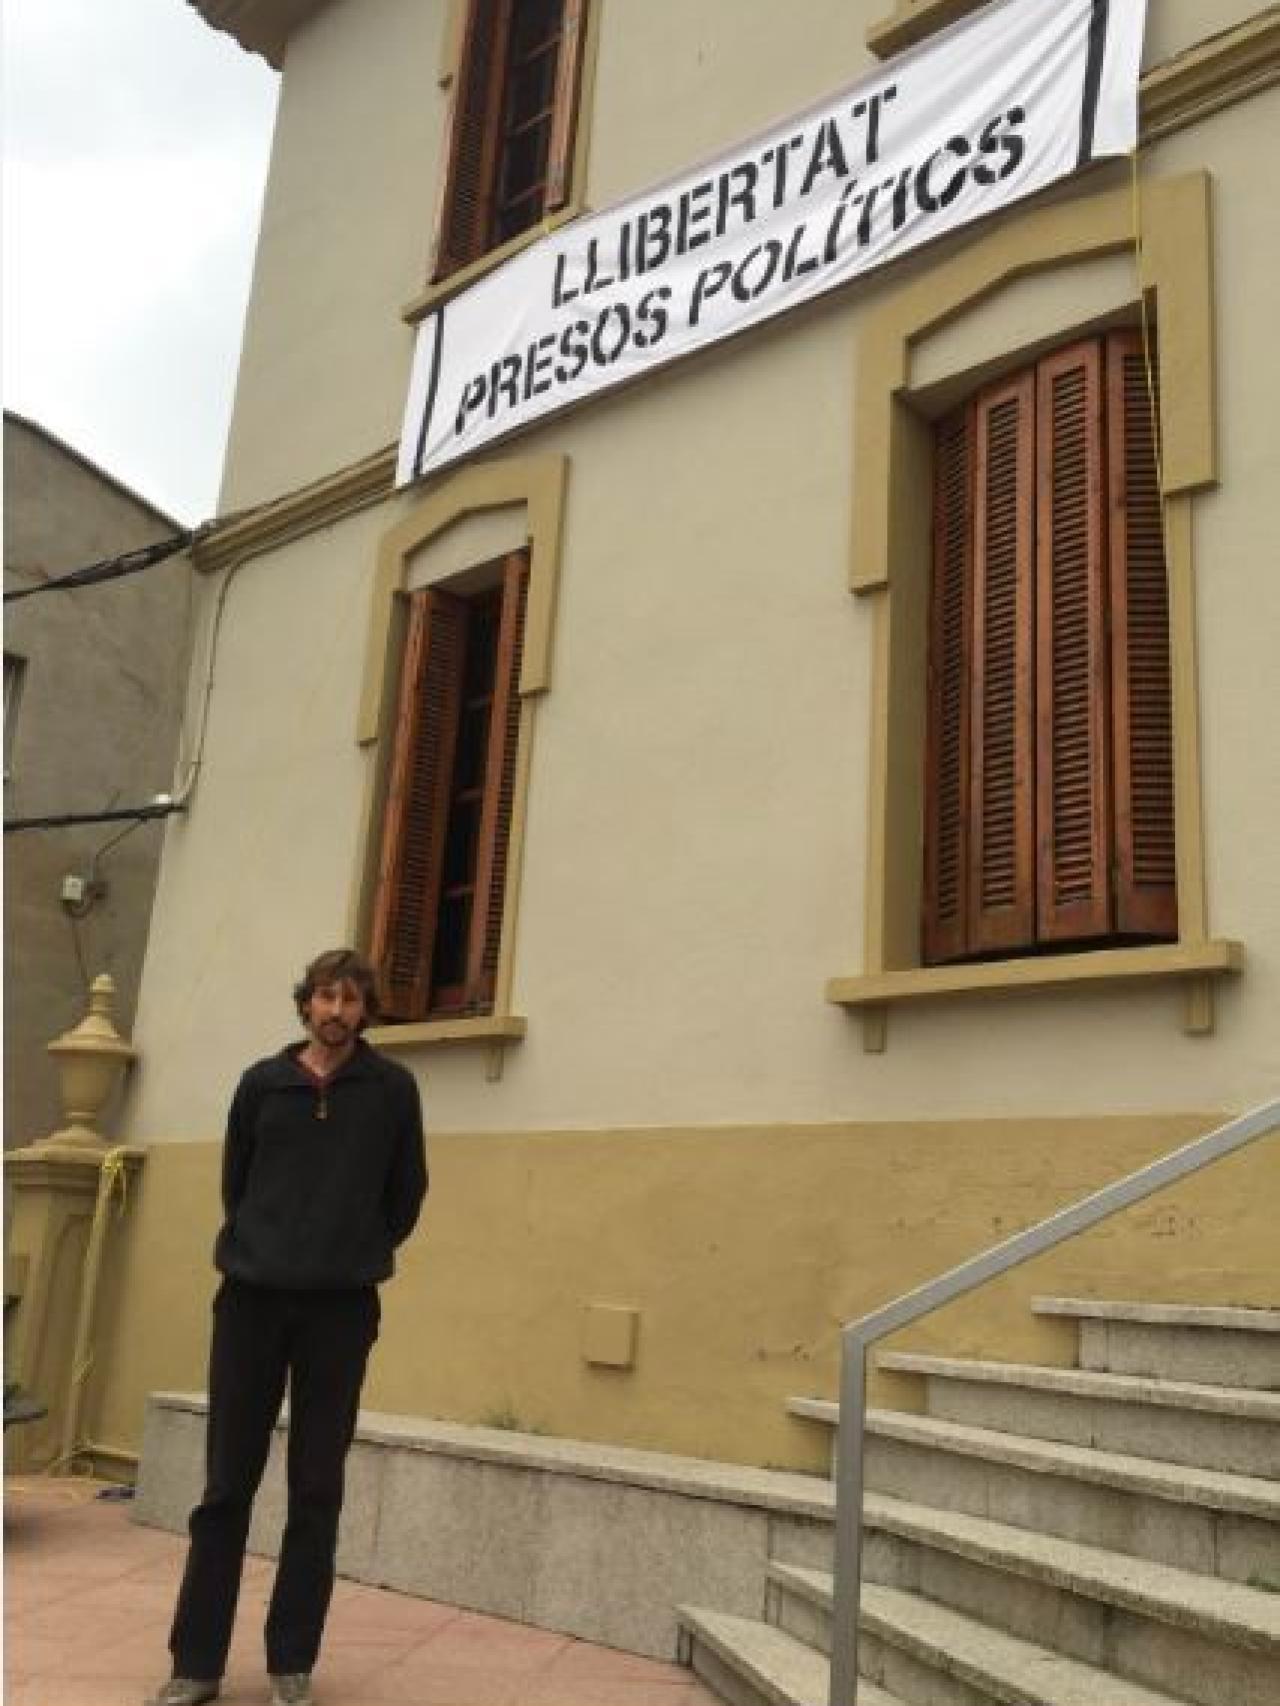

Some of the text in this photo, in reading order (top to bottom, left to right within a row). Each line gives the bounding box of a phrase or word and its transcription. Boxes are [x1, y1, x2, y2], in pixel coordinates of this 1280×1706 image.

[456, 108, 1025, 435] PRESOS POLÍTICS
[554, 87, 896, 308] LLIBERTAT
